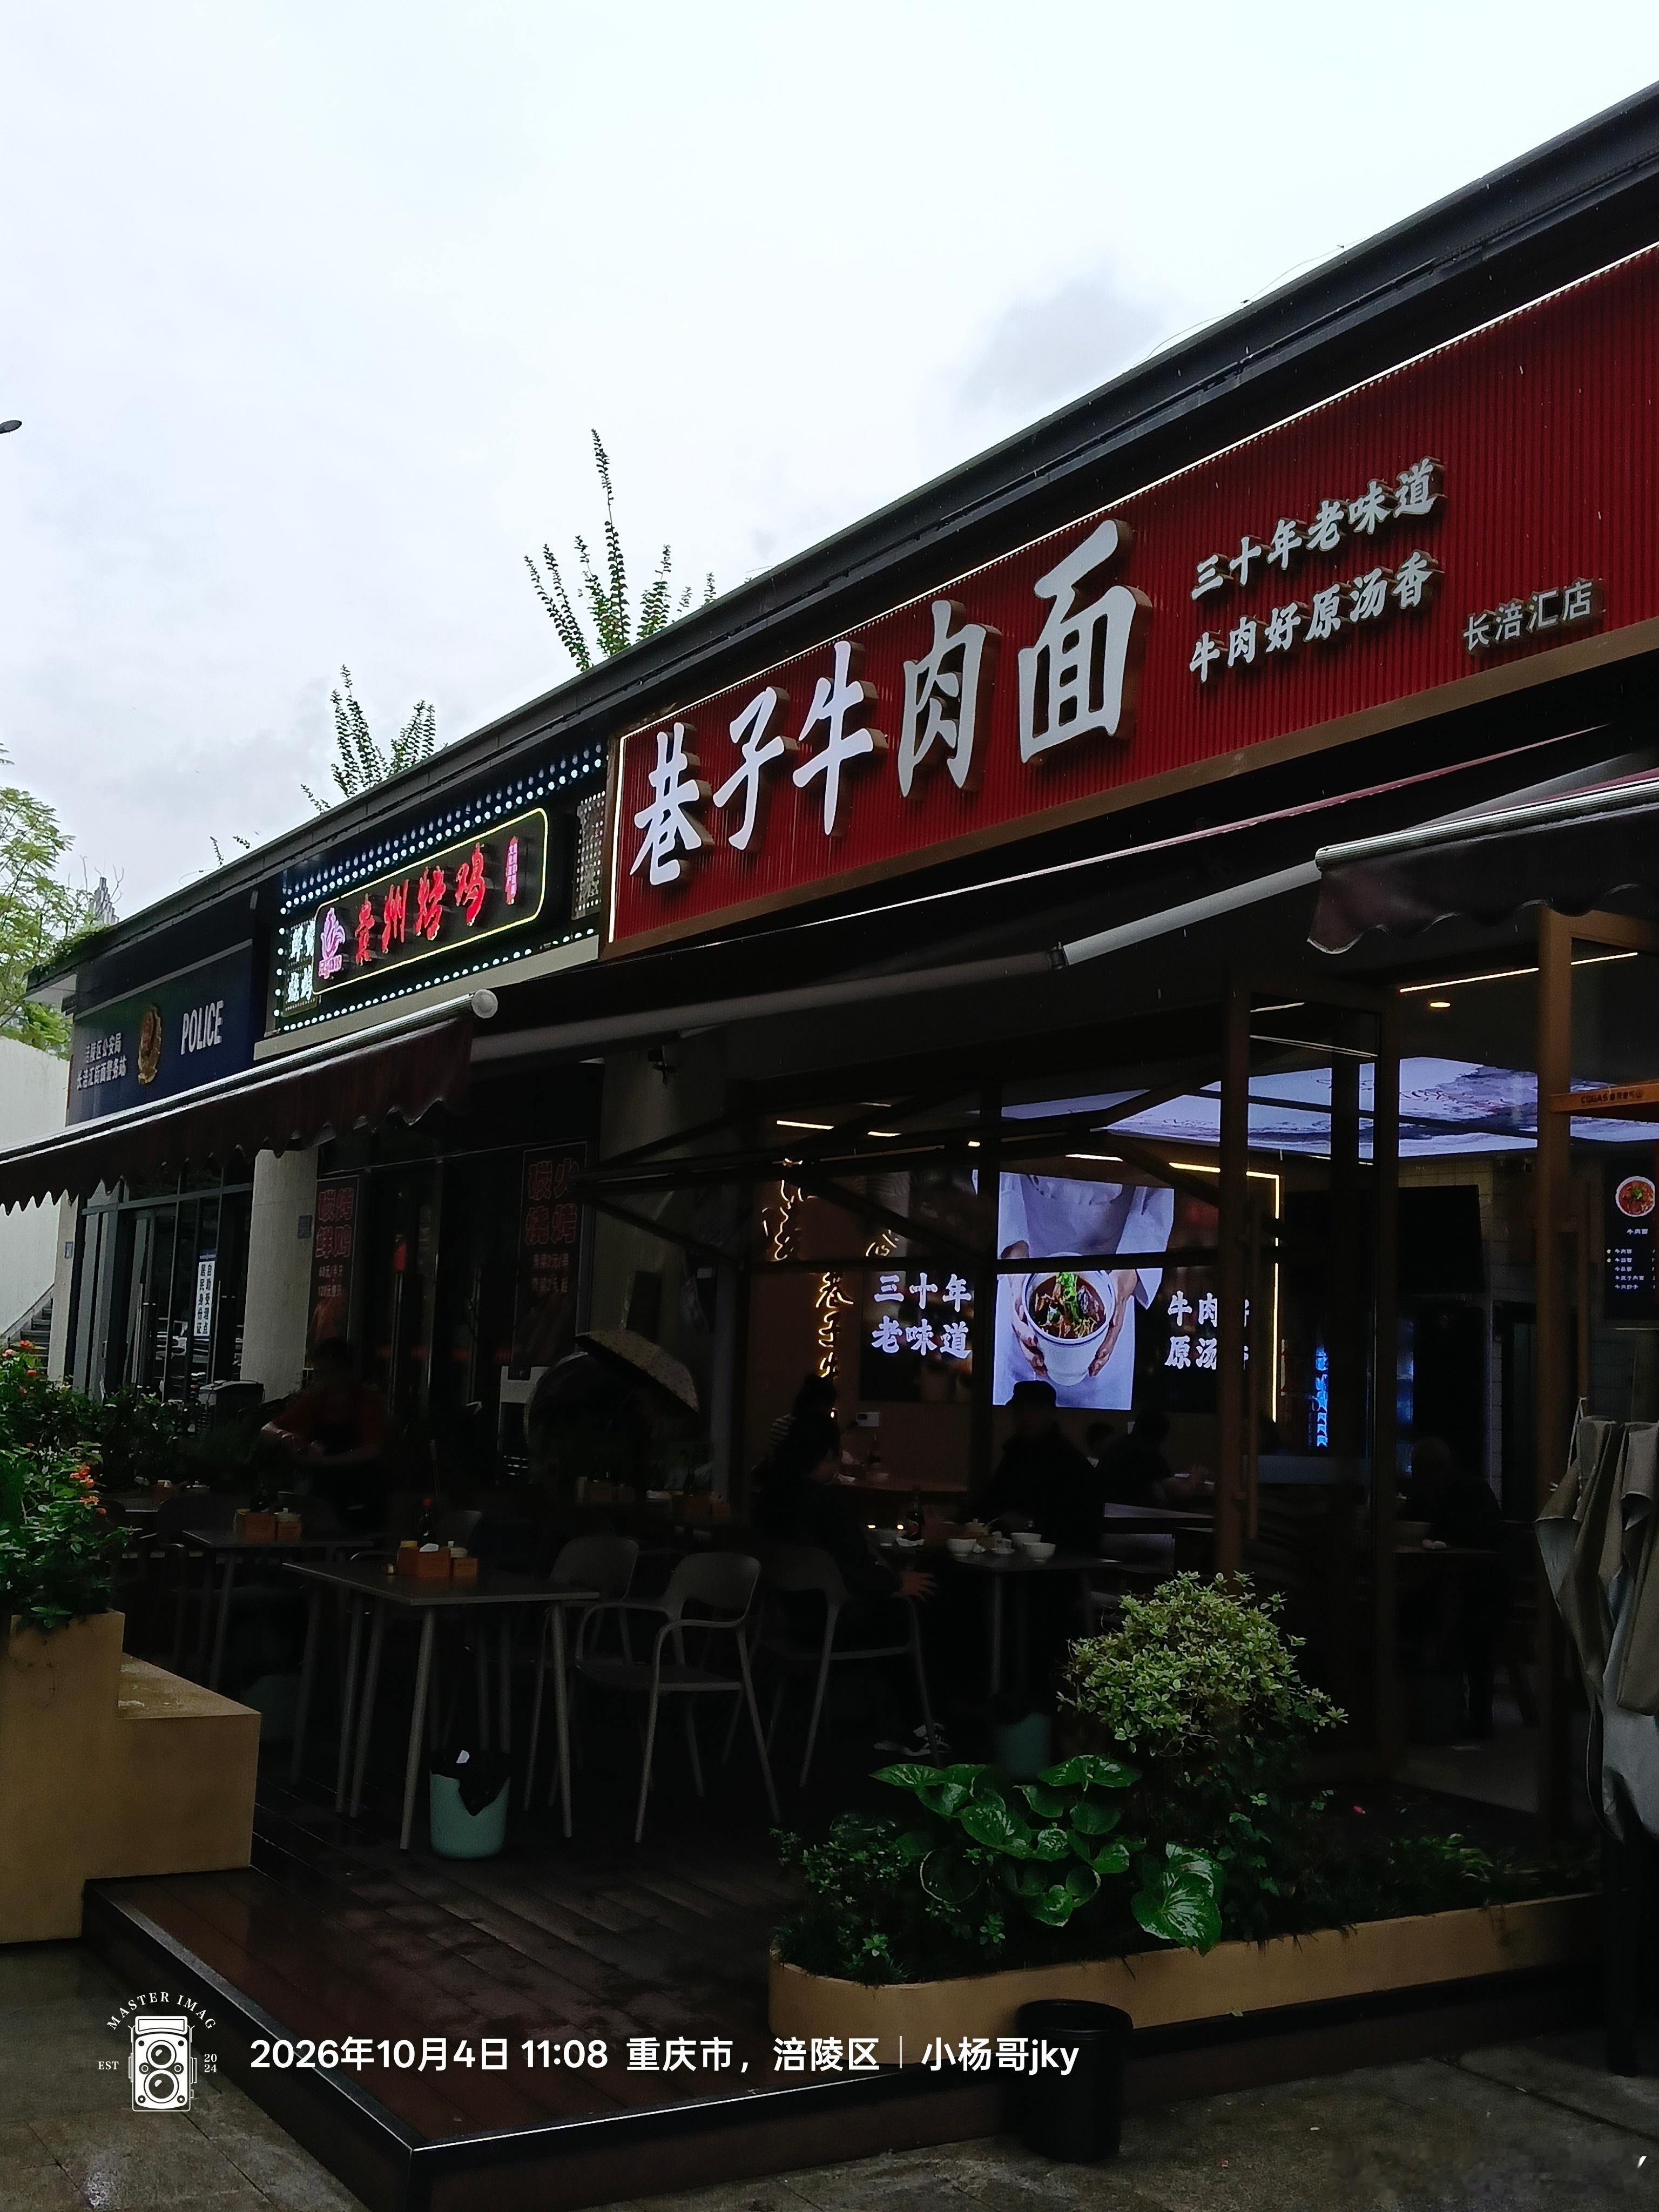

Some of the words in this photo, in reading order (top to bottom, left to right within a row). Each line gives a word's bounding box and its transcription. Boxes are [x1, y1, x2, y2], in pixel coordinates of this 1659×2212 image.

[1191, 457, 1435, 601] 三十年老味道
[1189, 551, 1433, 683] 牛肉好原汤香
[1463, 582, 1593, 651] 长涪汇店
[630, 519, 1139, 887] 巷子牛肉面
[85, 1032, 122, 1064] 涪陵区公安局
[180, 1000, 225, 1056] POLICE
[874, 1272, 972, 1312] 三十年
[1168, 1290, 1250, 1327] 牛肉
[871, 1315, 972, 1359] 老味道
[1164, 1335, 1250, 1371] 原汤
